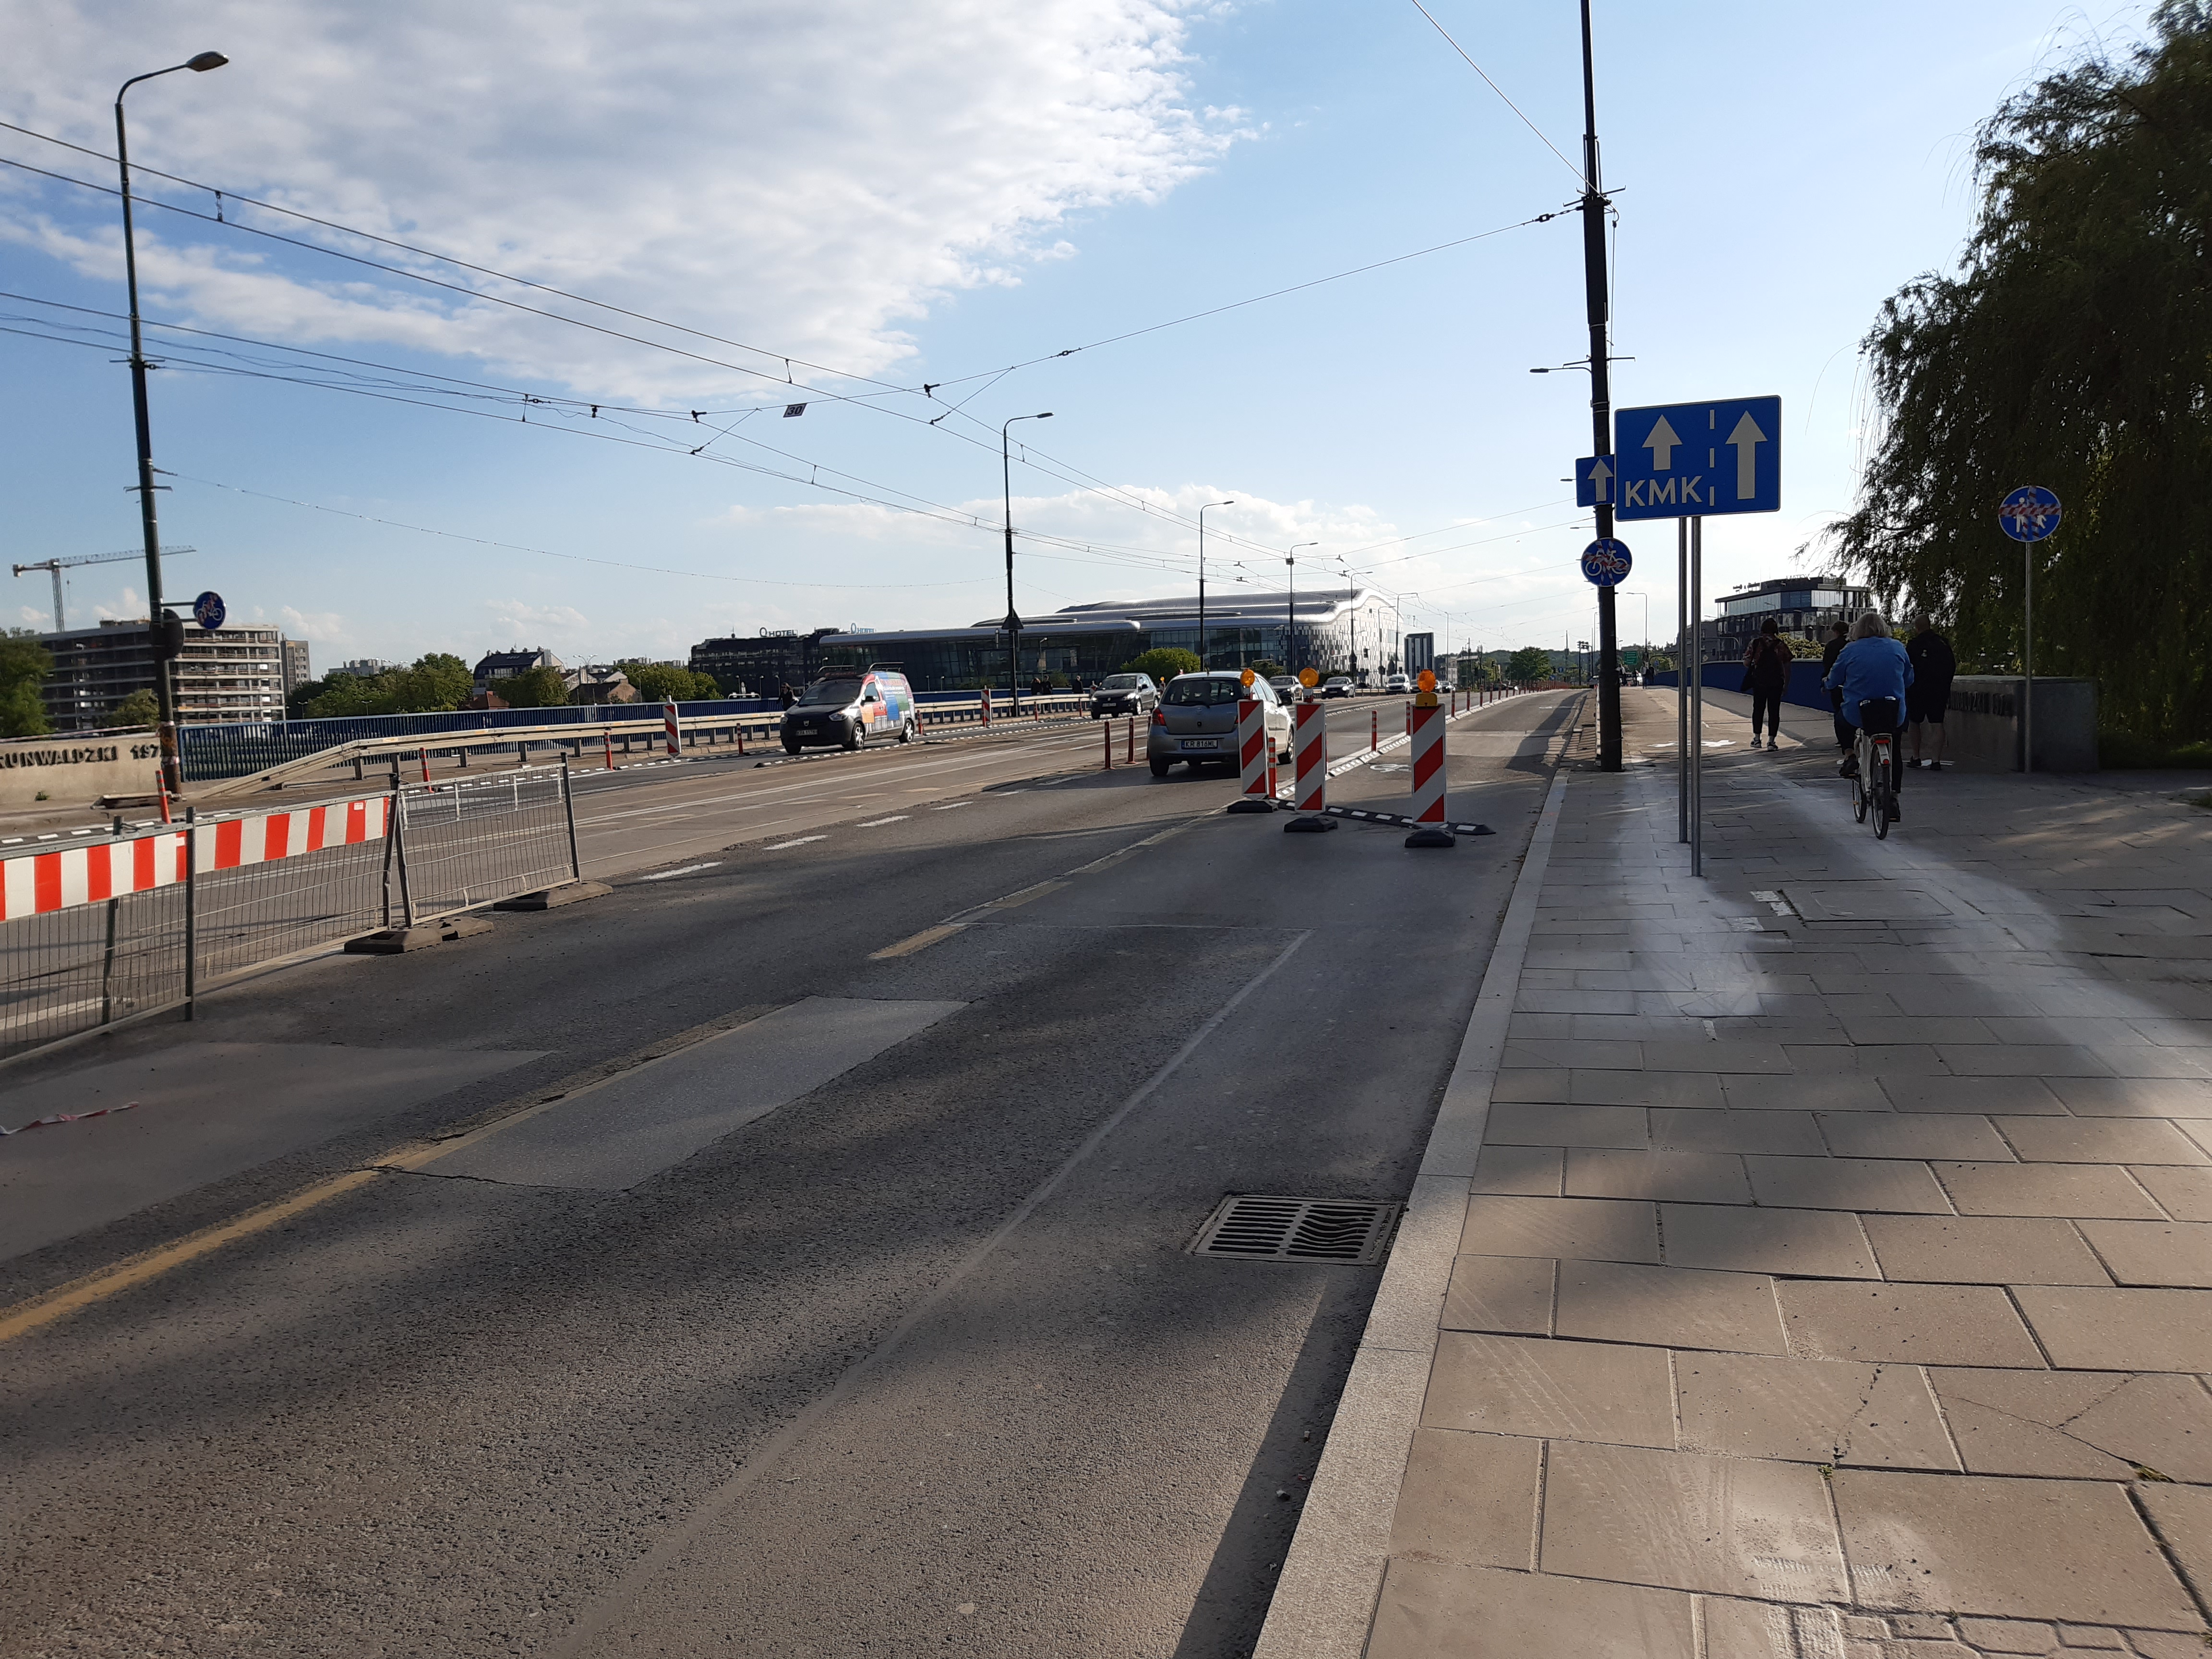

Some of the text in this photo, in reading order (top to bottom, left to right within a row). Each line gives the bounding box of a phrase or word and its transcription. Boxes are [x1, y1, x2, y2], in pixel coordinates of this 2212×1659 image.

[787, 406, 803, 415] 30
[1625, 475, 1702, 507] KMK
[130, 744, 160, 759] 197
